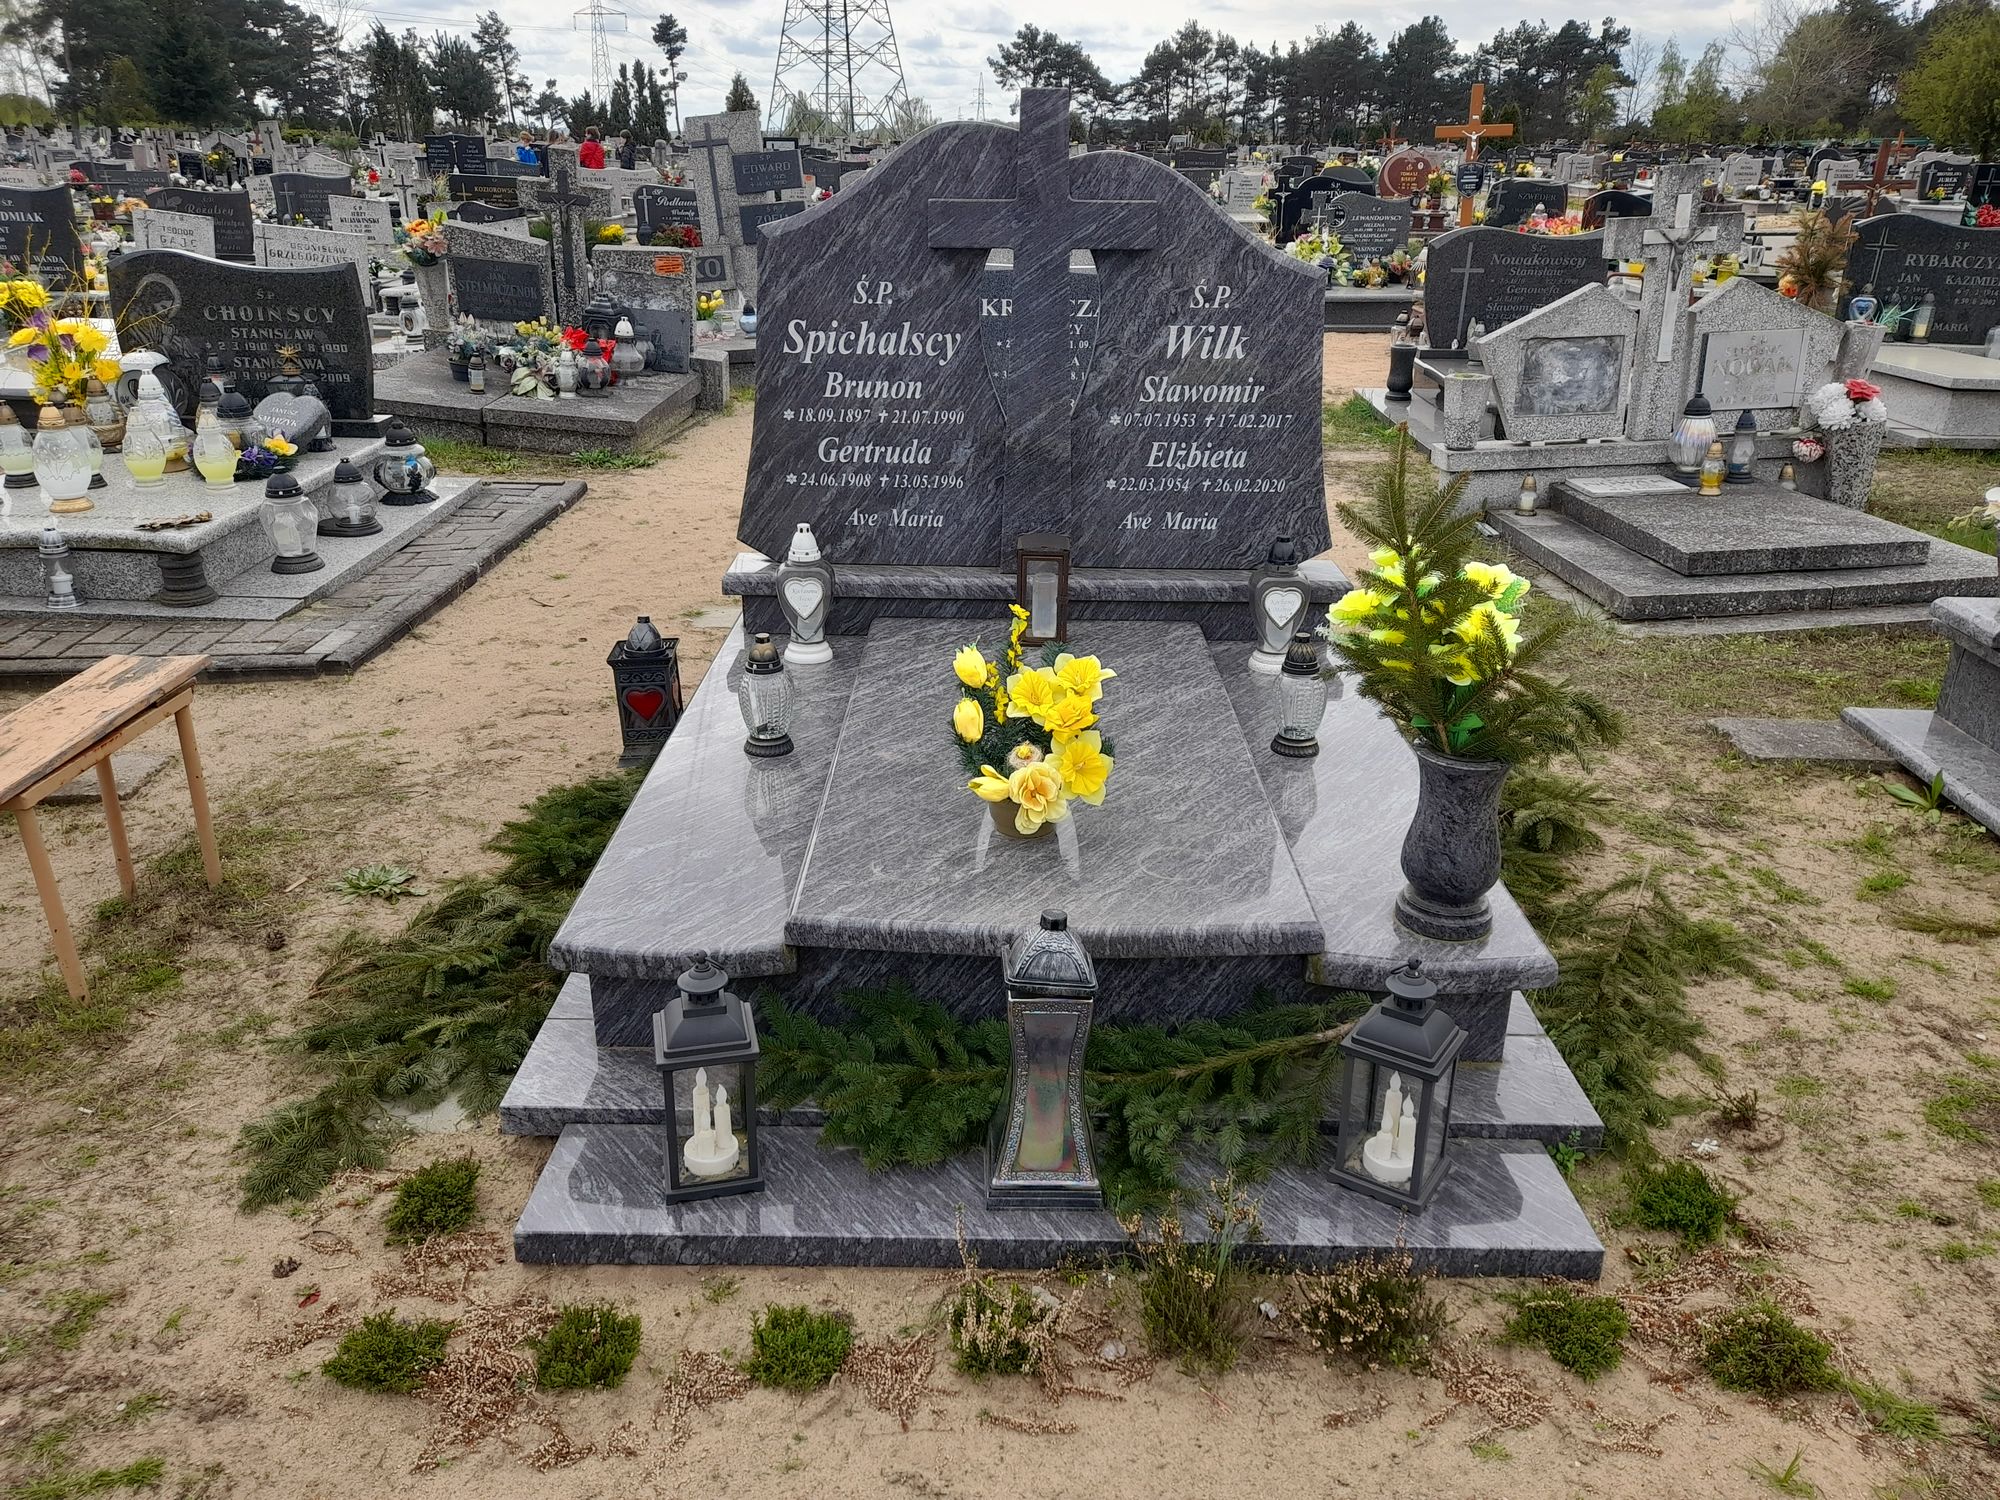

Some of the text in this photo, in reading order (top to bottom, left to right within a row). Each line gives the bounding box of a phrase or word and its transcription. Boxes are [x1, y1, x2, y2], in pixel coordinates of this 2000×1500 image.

[742, 161, 791, 175] EDWARD
[1490, 253, 1587, 268] Nowakowscy
[1905, 253, 2000, 270] RYBARCZY
[1897, 272, 1922, 283] JAN
[853, 274, 894, 305] Ś.P.
[1190, 279, 1232, 309] Ś.P.
[1507, 284, 1560, 295] Genowefa
[231, 327, 315, 341] STANISŁAW
[1932, 322, 1969, 332] MARIA
[783, 319, 962, 366] Spichalscy
[1167, 324, 1250, 360] Wilk
[320, 373, 351, 382] 2009
[823, 371, 923, 399] Brunon
[1139, 375, 1265, 403] Sławomir
[798, 408, 965, 425] 18.09.1897 21.07.1990
[1123, 412, 1292, 429] 07.07.1953 17.02.2017
[818, 437, 932, 465] Gertruda
[1146, 441, 1249, 470] Elżbieta
[800, 472, 964, 489] 24.06.1908 13.05.1996
[1119, 477, 1286, 493] 22.03.1954 26.02.2020
[845, 508, 944, 528] Ave Maria
[1118, 511, 1219, 530] Ave Maria
